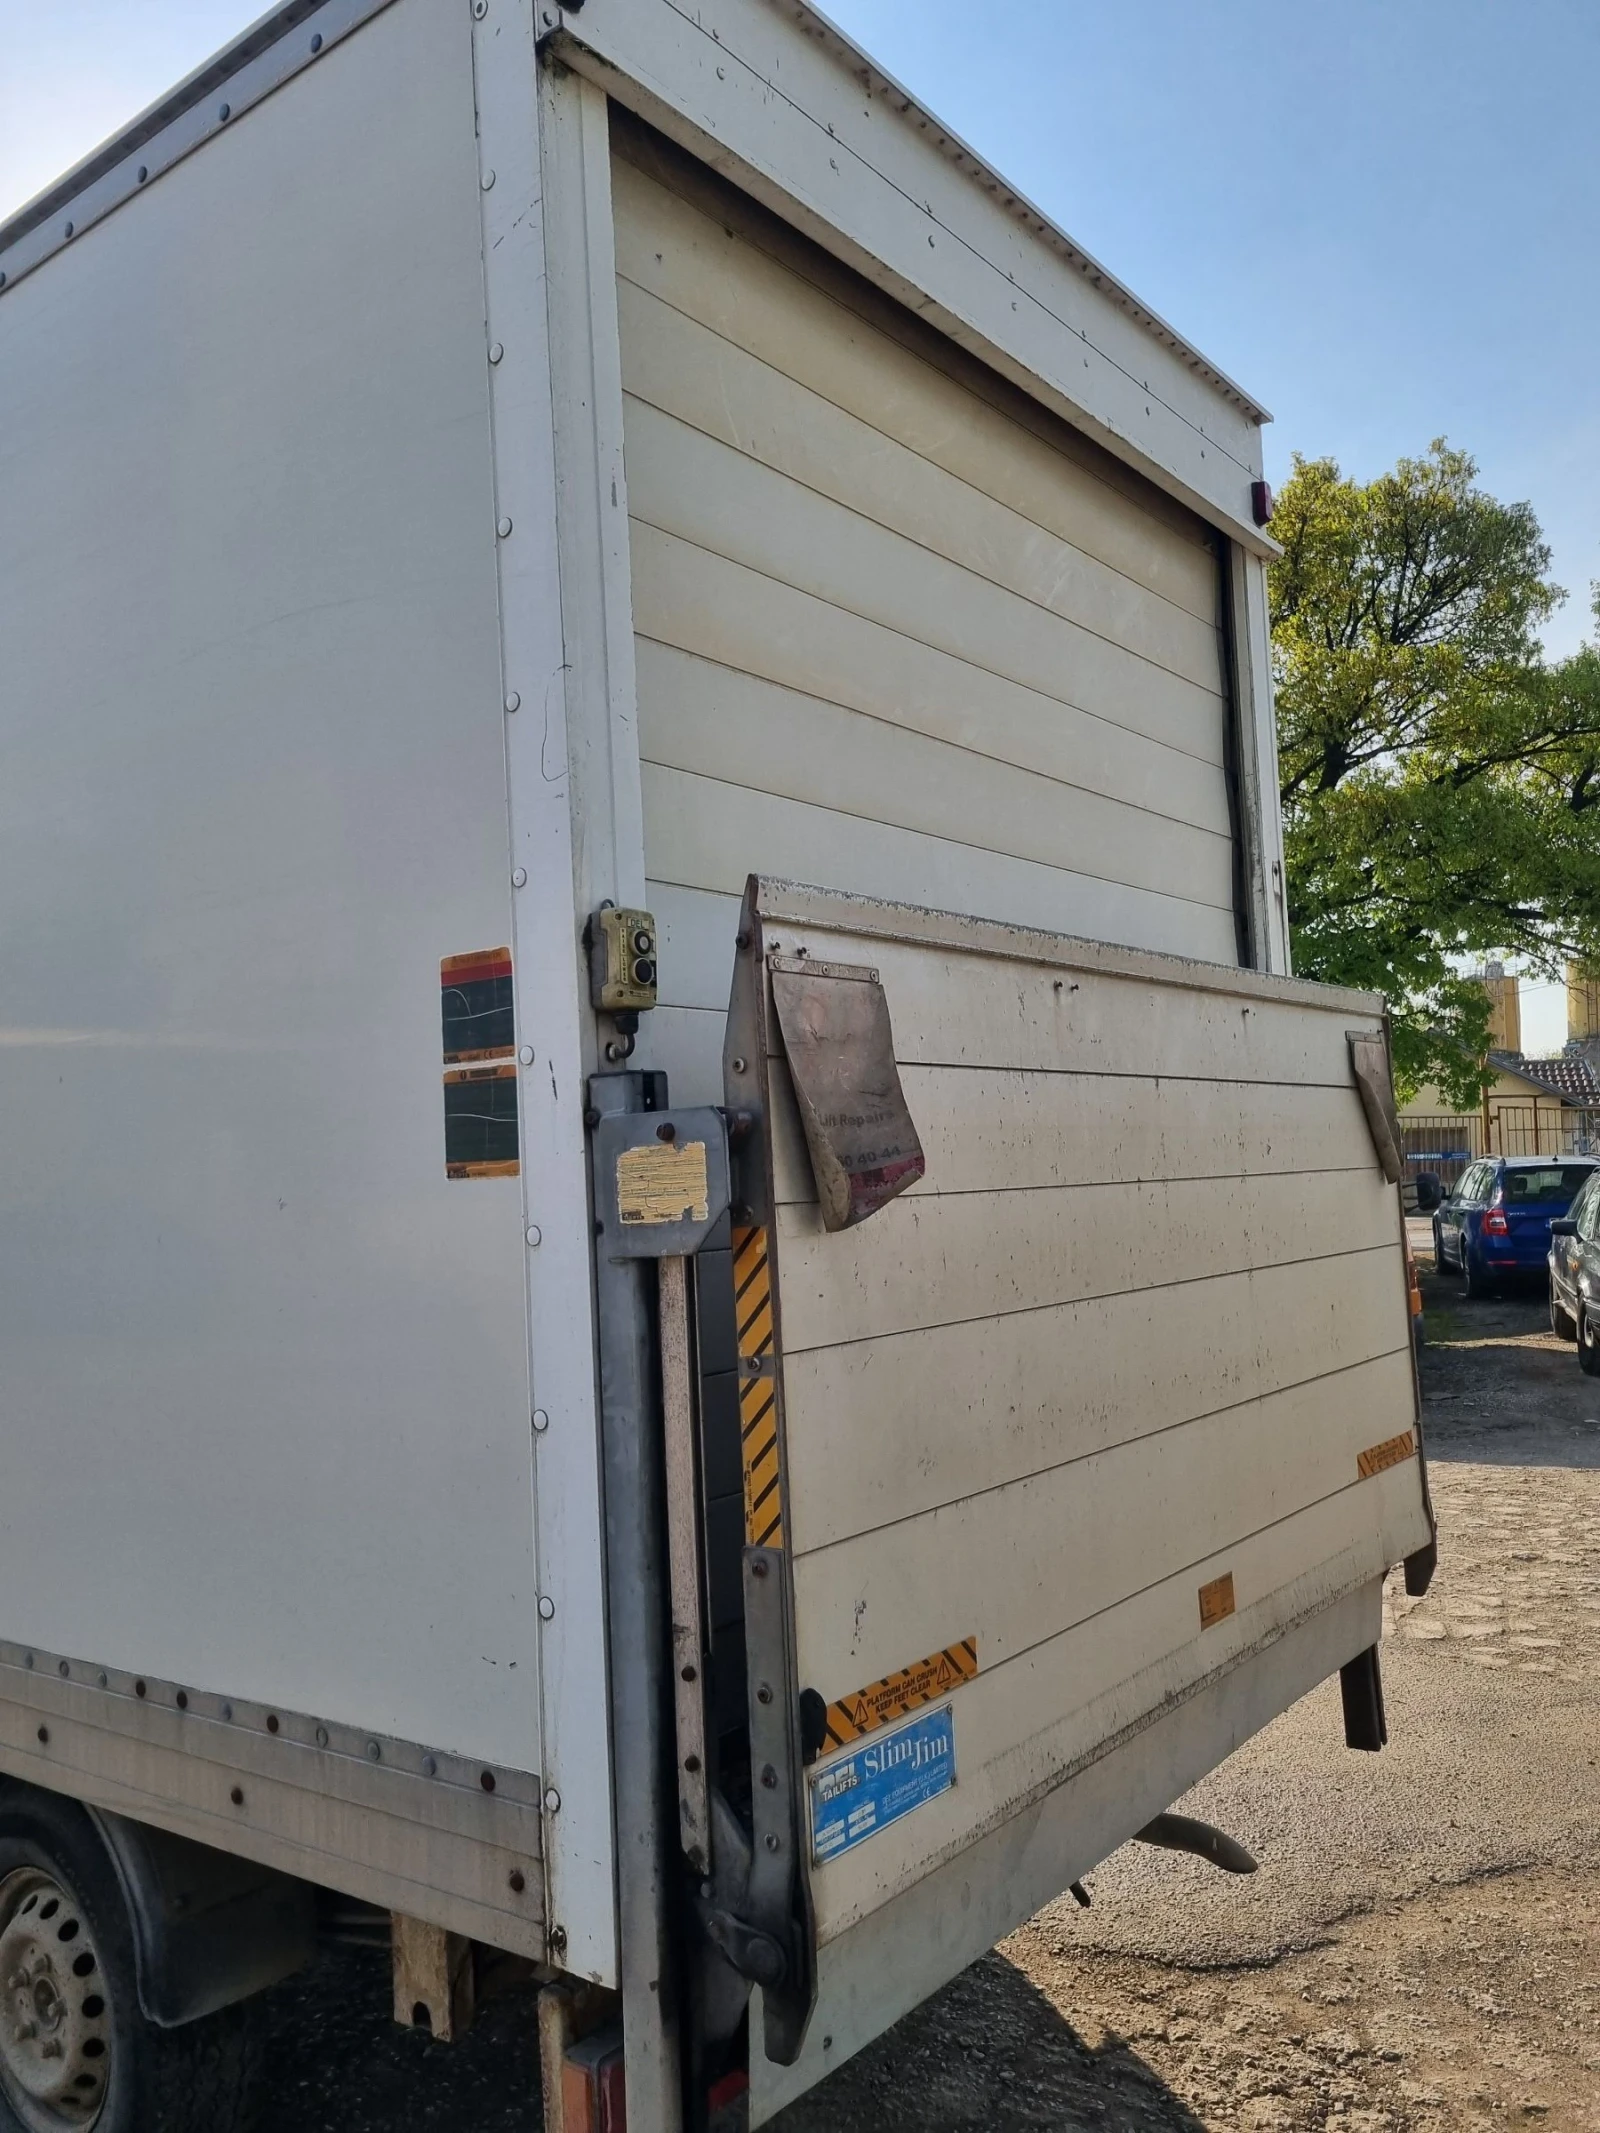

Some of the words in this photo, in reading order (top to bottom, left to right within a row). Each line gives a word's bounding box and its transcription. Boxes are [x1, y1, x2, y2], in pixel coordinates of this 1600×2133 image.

[867, 1683, 901, 1708] PLATFORM
[902, 1676, 915, 1690] CAN
[917, 1666, 937, 1681] CRUSH
[876, 1698, 892, 1713] KEEP
[894, 1691, 910, 1705] FEET
[911, 1680, 931, 1696] CLEAR
[864, 1737, 913, 1780] Slim
[911, 1735, 949, 1770] Jim
[823, 1776, 858, 1802] TAILIFTS
